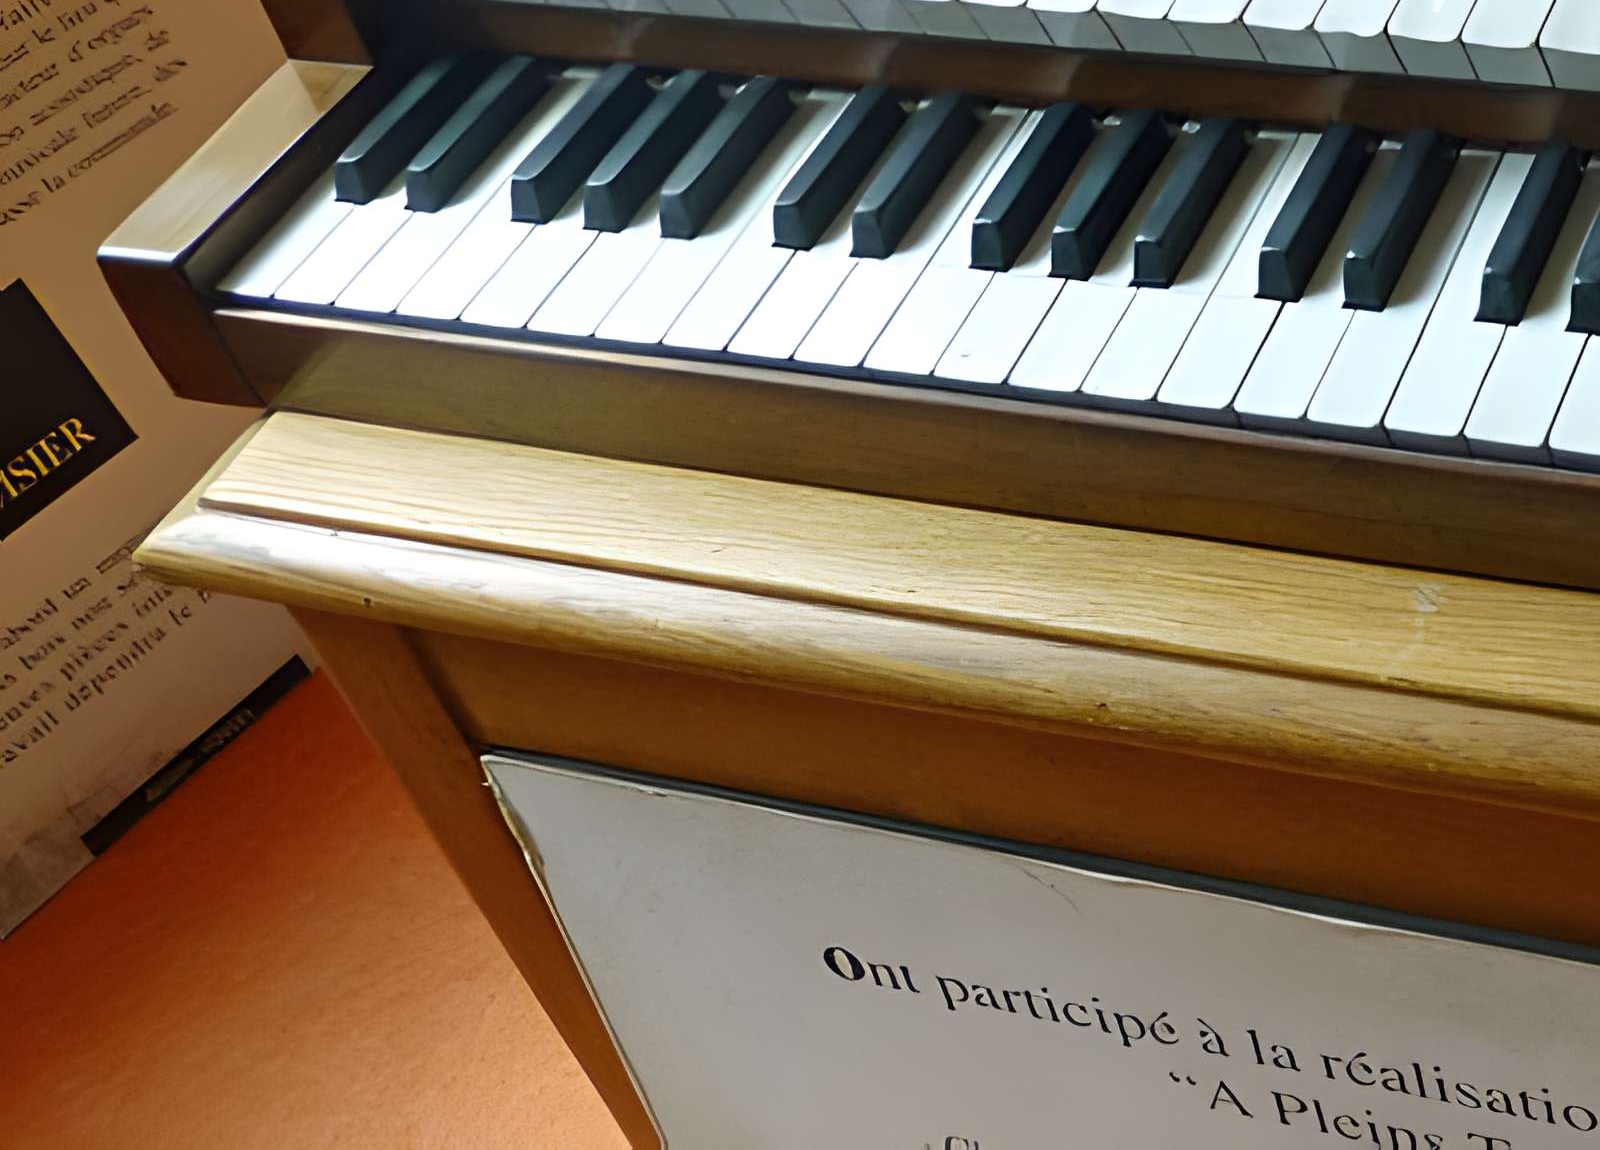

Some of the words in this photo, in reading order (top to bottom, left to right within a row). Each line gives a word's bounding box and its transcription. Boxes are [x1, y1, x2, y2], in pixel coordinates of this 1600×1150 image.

[823, 946, 920, 993] Ont
[936, 974, 1180, 1047] participé
[1196, 1018, 1230, 1057] à
[1246, 1029, 1301, 1072] la
